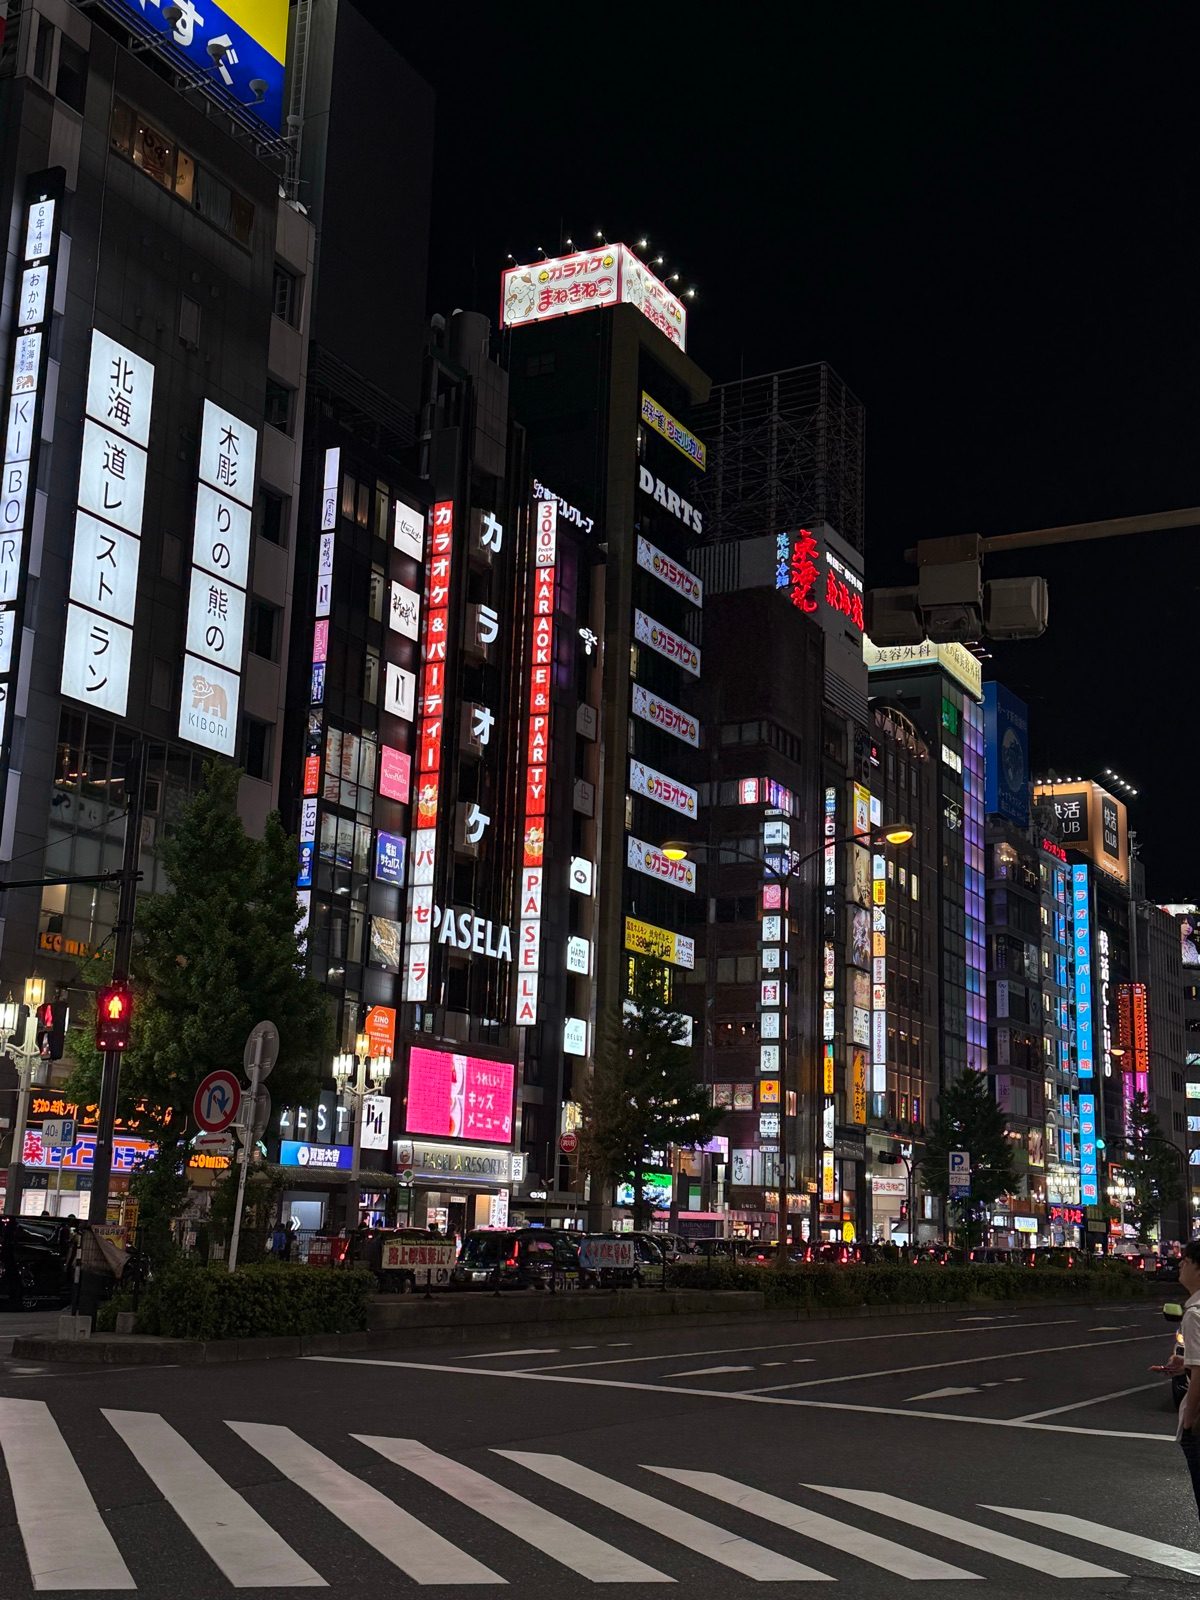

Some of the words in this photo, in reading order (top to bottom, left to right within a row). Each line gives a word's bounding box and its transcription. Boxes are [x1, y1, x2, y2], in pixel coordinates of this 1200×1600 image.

[33, 206, 45, 255] 6年4組
[548, 254, 603, 282] カラオケ
[27, 274, 41, 320] おかか
[537, 275, 614, 312] まねきねこ
[26, 338, 36, 371] 北海道
[0, 400, 29, 594] KIBORI
[639, 464, 702, 535] DARTS
[204, 425, 239, 653] 木彫りの熊の
[541, 504, 553, 547] 300
[537, 553, 553, 563] OK
[660, 557, 693, 594] カラオケ
[535, 568, 551, 684] KARAOKE
[657, 630, 692, 665] カラオケ
[874, 643, 931, 664] 美容外科
[188, 711, 229, 740] KIBORI
[655, 703, 690, 736] カラオケ
[531, 717, 546, 799] PARTY
[653, 778, 688, 810] カラオケ
[651, 852, 687, 882] カラオケ
[411, 848, 435, 982] パセラ
[433, 905, 513, 963] PASELA
[518, 875, 540, 1020] PASELA
[474, 1073, 500, 1086] うれしい
[468, 1091, 494, 1110] キッズ
[467, 1112, 499, 1129] メニュー
[24, 1130, 44, 1164] 薬
[308, 1147, 341, 1163] 買取大吉
[950, 1154, 965, 1171] P
